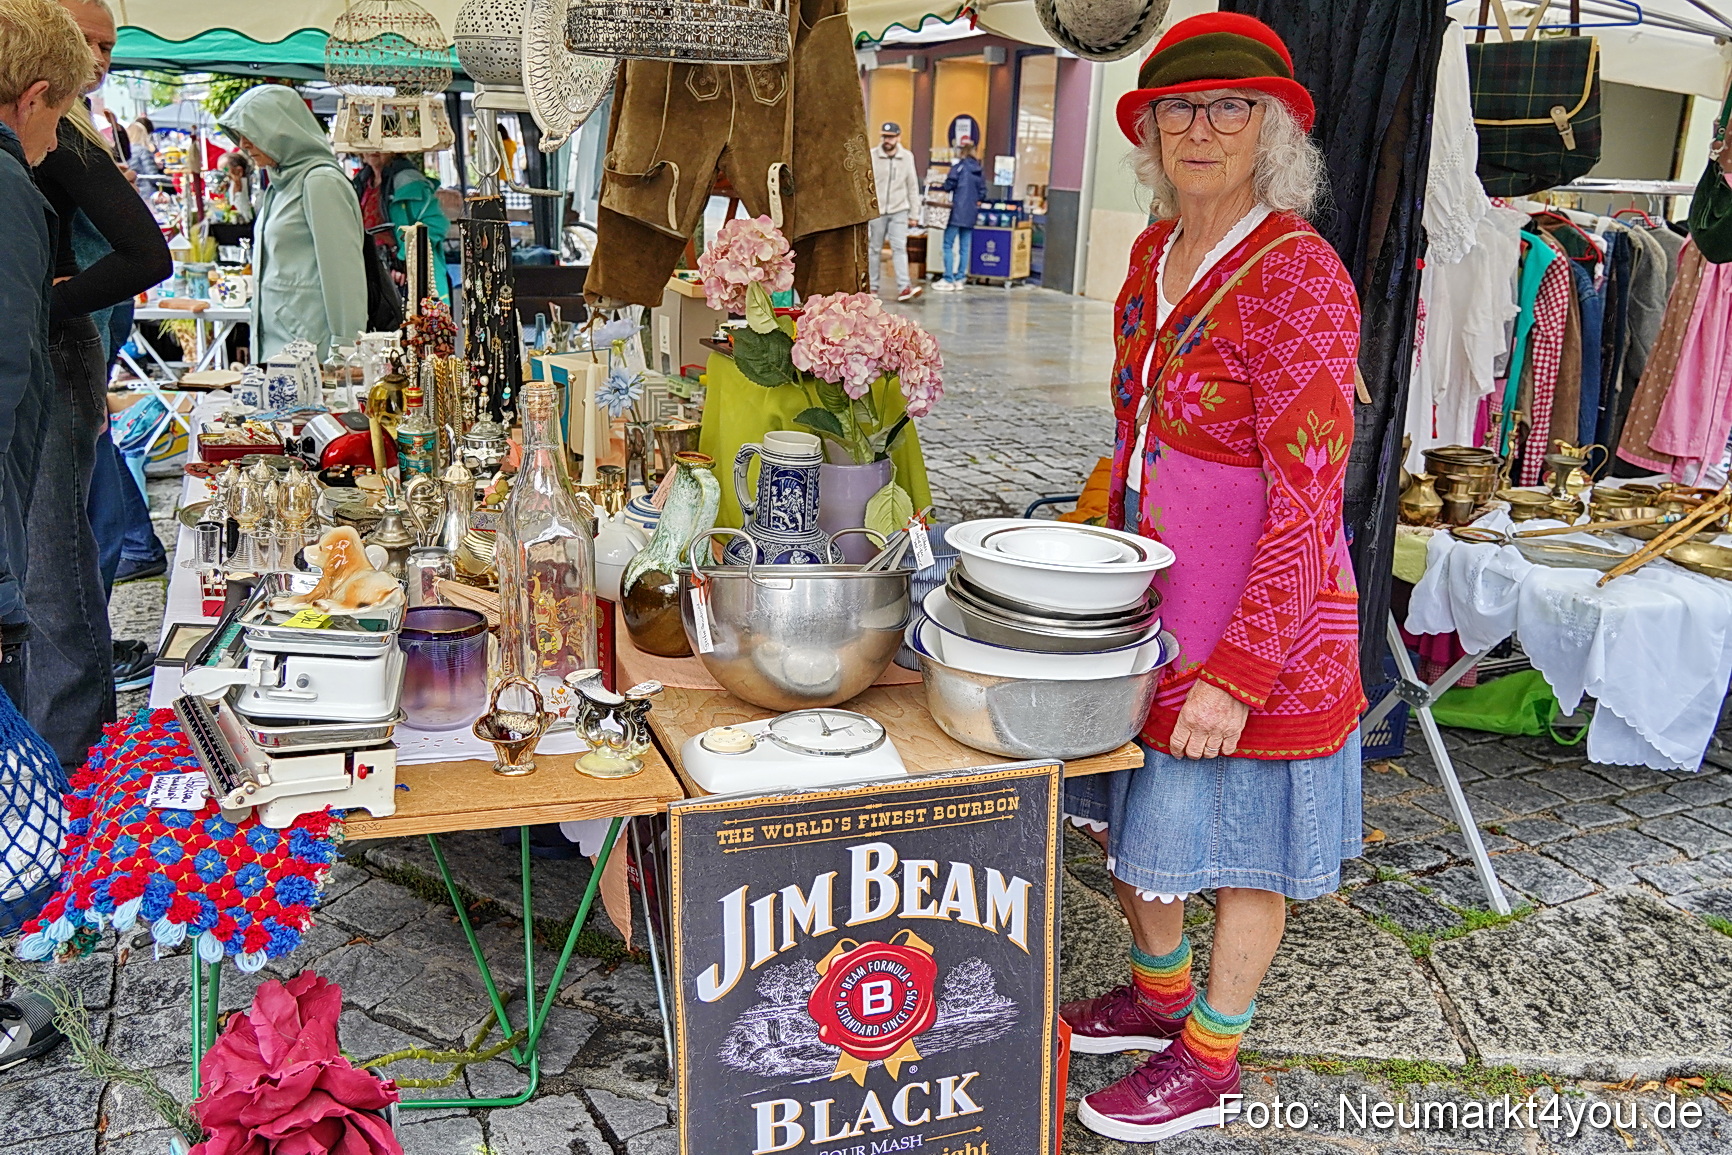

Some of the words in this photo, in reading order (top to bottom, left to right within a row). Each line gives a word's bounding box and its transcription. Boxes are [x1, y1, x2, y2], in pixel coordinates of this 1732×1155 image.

[716, 827, 754, 845] THE
[761, 816, 851, 840] WORLD'S
[858, 808, 927, 830] FINEST
[933, 796, 1020, 821] BOURBON
[696, 871, 839, 1003] JIM
[845, 841, 1033, 955] BEAM
[841, 965, 867, 990] BEAM
[867, 960, 911, 982] FORMULA
[861, 980, 893, 1016] B
[837, 1007, 880, 1036] STANDARD
[881, 1010, 909, 1034] SINCE
[903, 989, 919, 1011] 1795
[751, 1071, 984, 1155] BLACK
[870, 1134, 923, 1155] MASH
